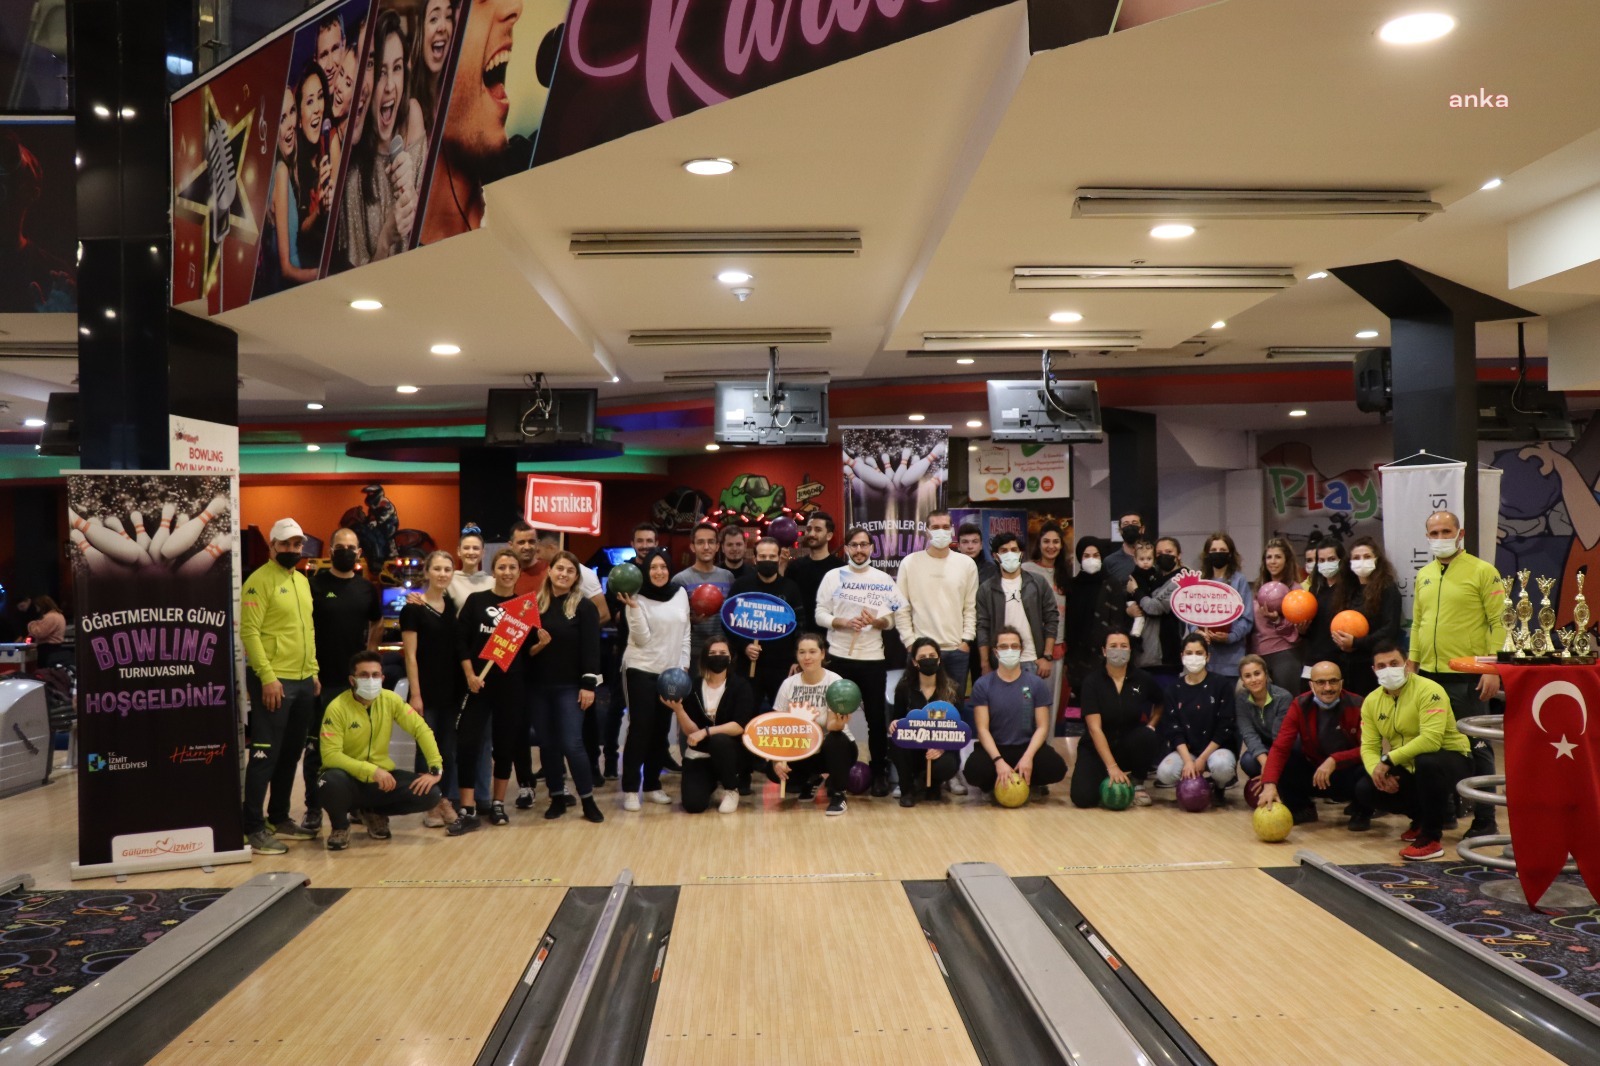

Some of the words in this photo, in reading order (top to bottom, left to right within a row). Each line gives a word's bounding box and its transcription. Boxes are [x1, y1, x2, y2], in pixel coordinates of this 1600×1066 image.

[533, 496, 548, 513] EN
[551, 492, 593, 513] STRİKER
[841, 582, 893, 592] KAZANIYORSAK
[1183, 590, 1228, 599] Turnuvanın
[736, 597, 785, 613] Turnuvanın
[1178, 603, 1193, 614] EN
[1194, 601, 1233, 614] GÜZELİ
[82, 607, 184, 633] ÖĞRETMENLER
[187, 607, 226, 627] GÜNÜ
[753, 609, 766, 618] EN
[91, 628, 218, 671] BOWLING
[119, 665, 195, 679] TURNUVASINA
[86, 681, 226, 717] HOŞGELDİNİZ
[908, 719, 937, 727] TIRNAK
[937, 719, 957, 728] DEĞİL
[756, 726, 770, 736] EN
[771, 725, 813, 735] SKORER
[896, 728, 931, 743] REKOR
[931, 729, 966, 742] KIRDIK
[758, 735, 812, 749] KADIN
[108, 756, 128, 764] İZMİT
[108, 761, 148, 771] BELEDİYESİ
